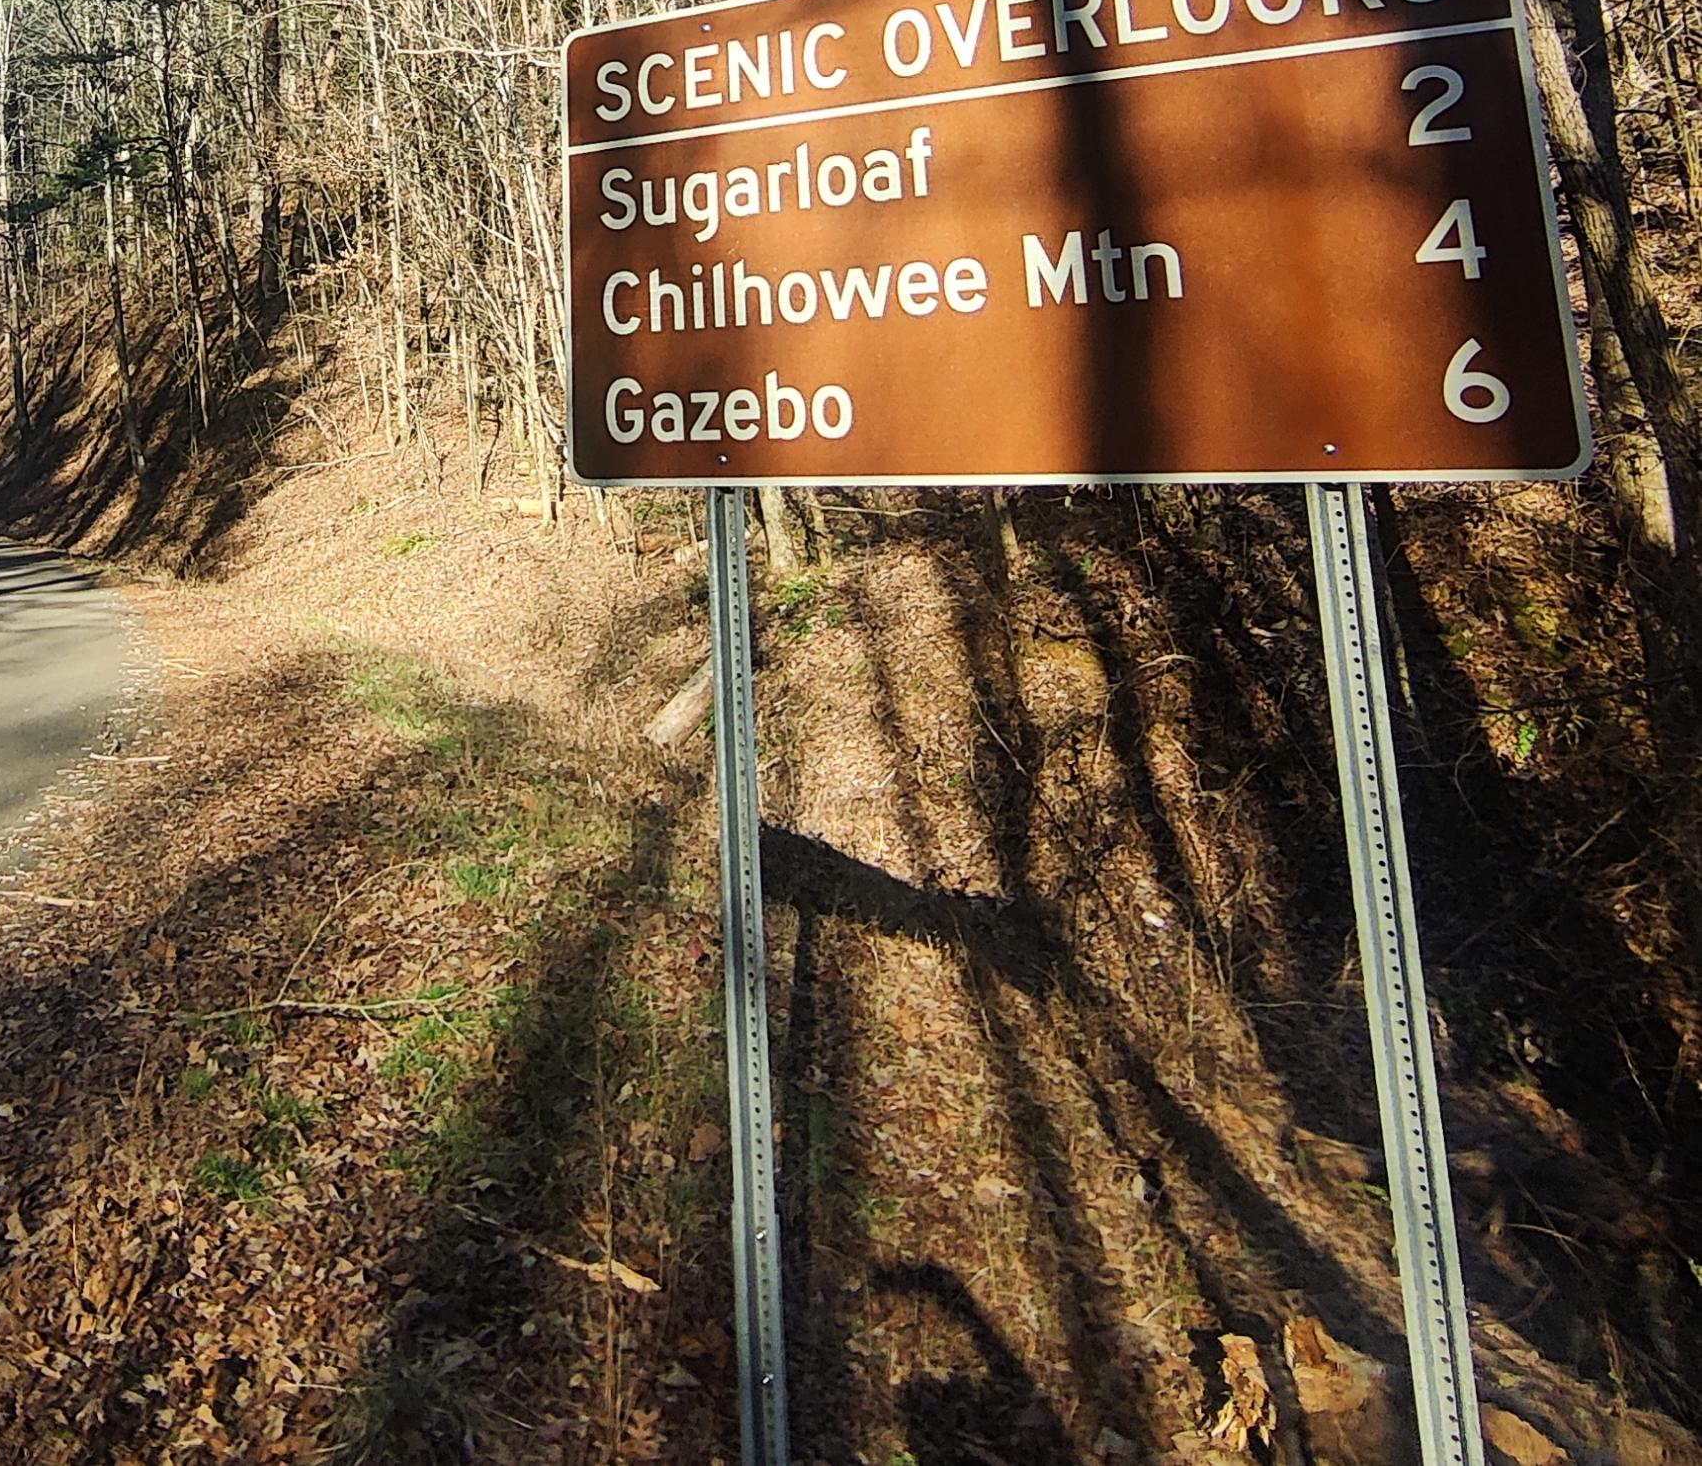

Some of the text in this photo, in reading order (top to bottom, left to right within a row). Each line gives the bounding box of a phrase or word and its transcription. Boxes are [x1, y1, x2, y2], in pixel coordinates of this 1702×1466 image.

[594, 20, 847, 122] SCENIC
[600, 65, 1473, 243] Sugarloaf 2
[602, 198, 1488, 335] Chilhowee Mtn 4
[604, 338, 1511, 445] Gazebo 6
